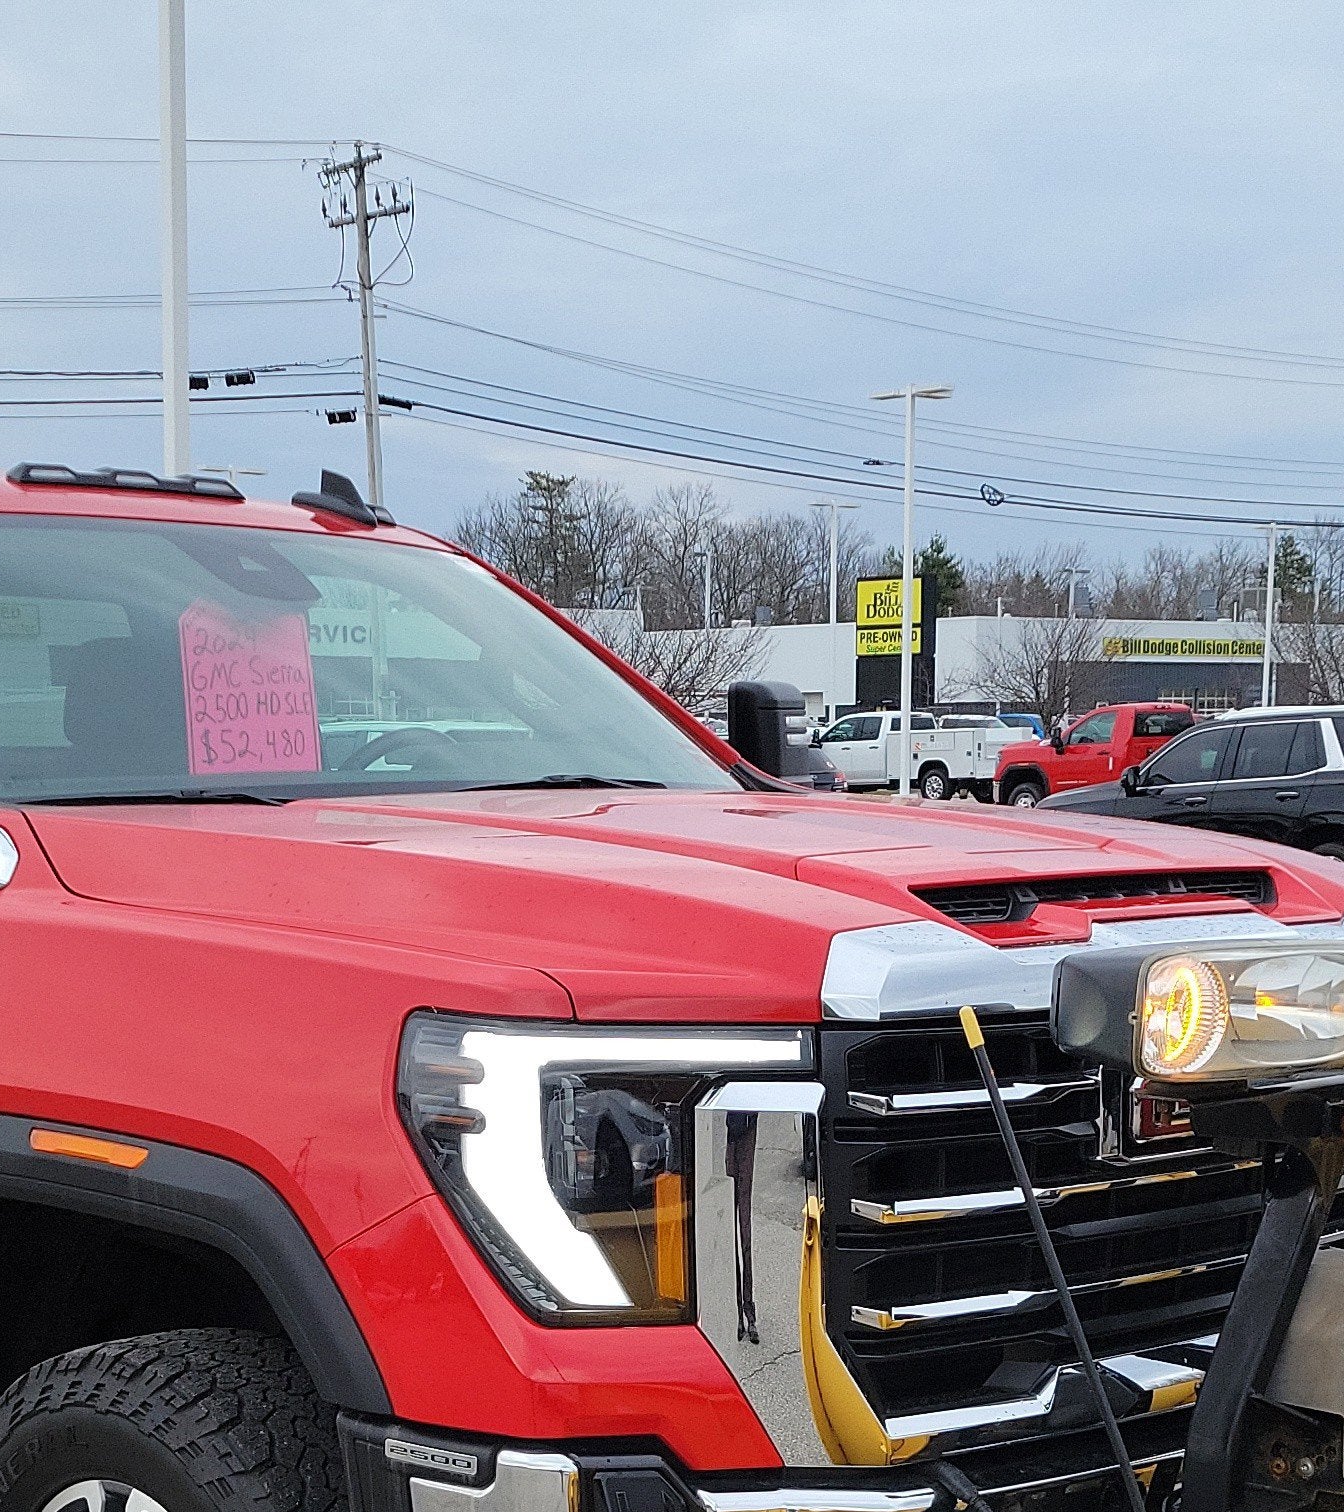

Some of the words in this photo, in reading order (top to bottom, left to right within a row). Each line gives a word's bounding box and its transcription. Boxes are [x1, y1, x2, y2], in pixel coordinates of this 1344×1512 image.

[866, 604, 903, 618] DODG
[859, 631, 918, 644] PRE-OWND
[1122, 639, 1141, 654] Bill
[1143, 640, 1178, 656] Dodge
[1180, 639, 1229, 654] Collision
[191, 660, 242, 691] GMC
[249, 656, 305, 685] Sierra
[195, 693, 249, 723] 2500
[200, 729, 305, 766] $52,480
[389, 1445, 472, 1469] 2500
